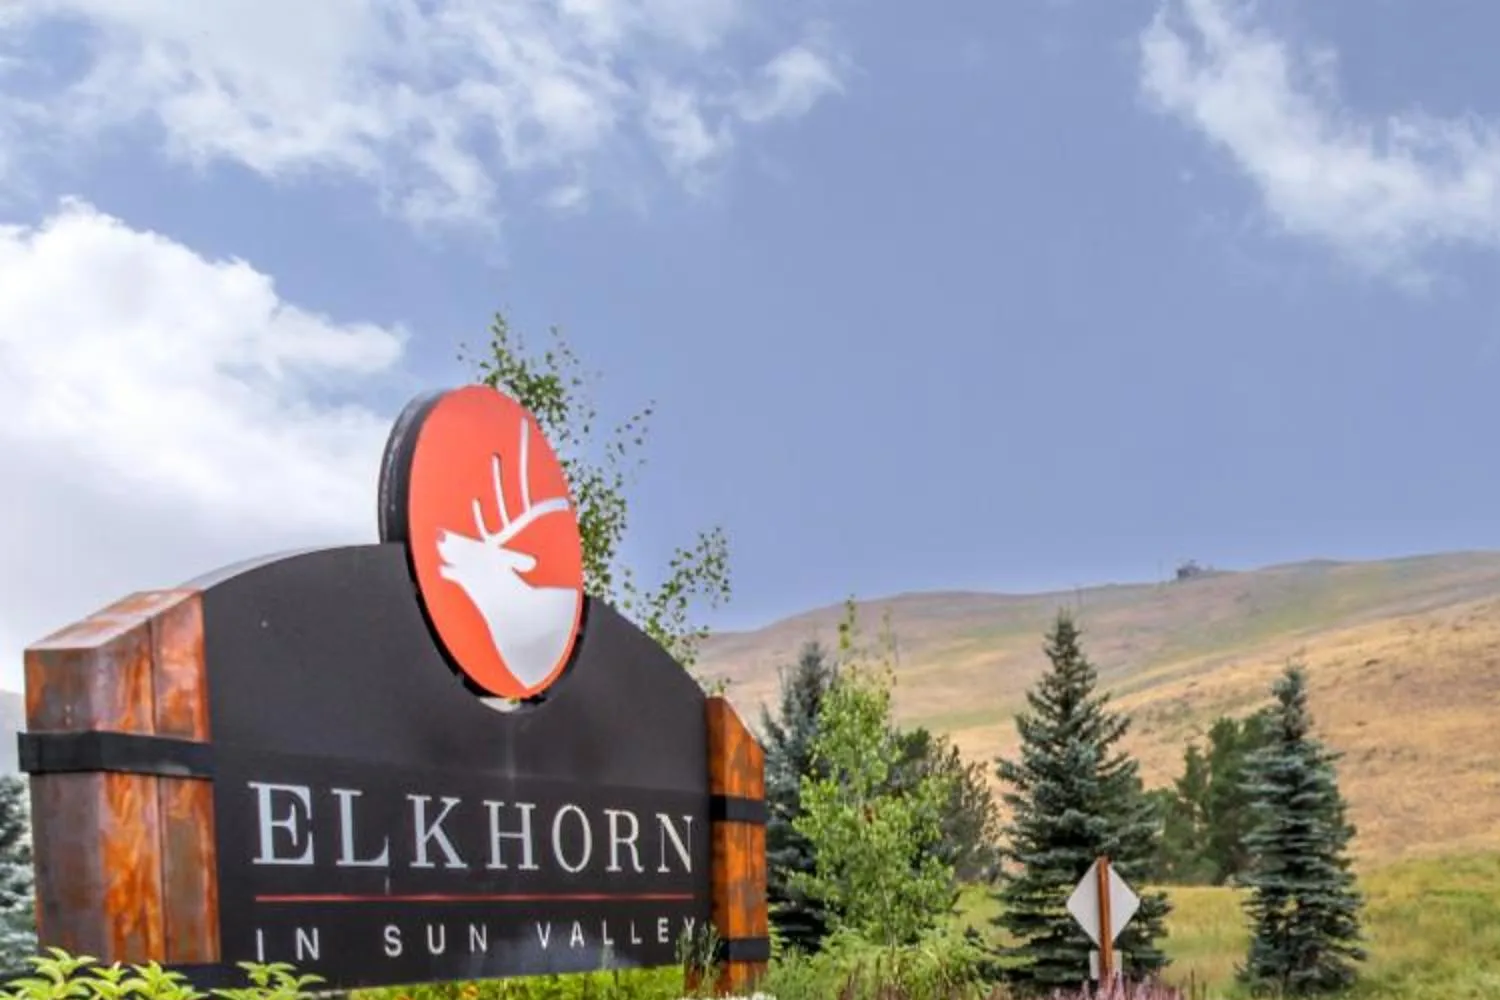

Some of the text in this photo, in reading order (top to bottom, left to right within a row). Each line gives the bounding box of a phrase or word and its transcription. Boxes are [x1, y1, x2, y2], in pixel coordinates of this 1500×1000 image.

[247, 781, 695, 875] ELKHORN
[256, 915, 696, 962] IN SUN VALLEY
